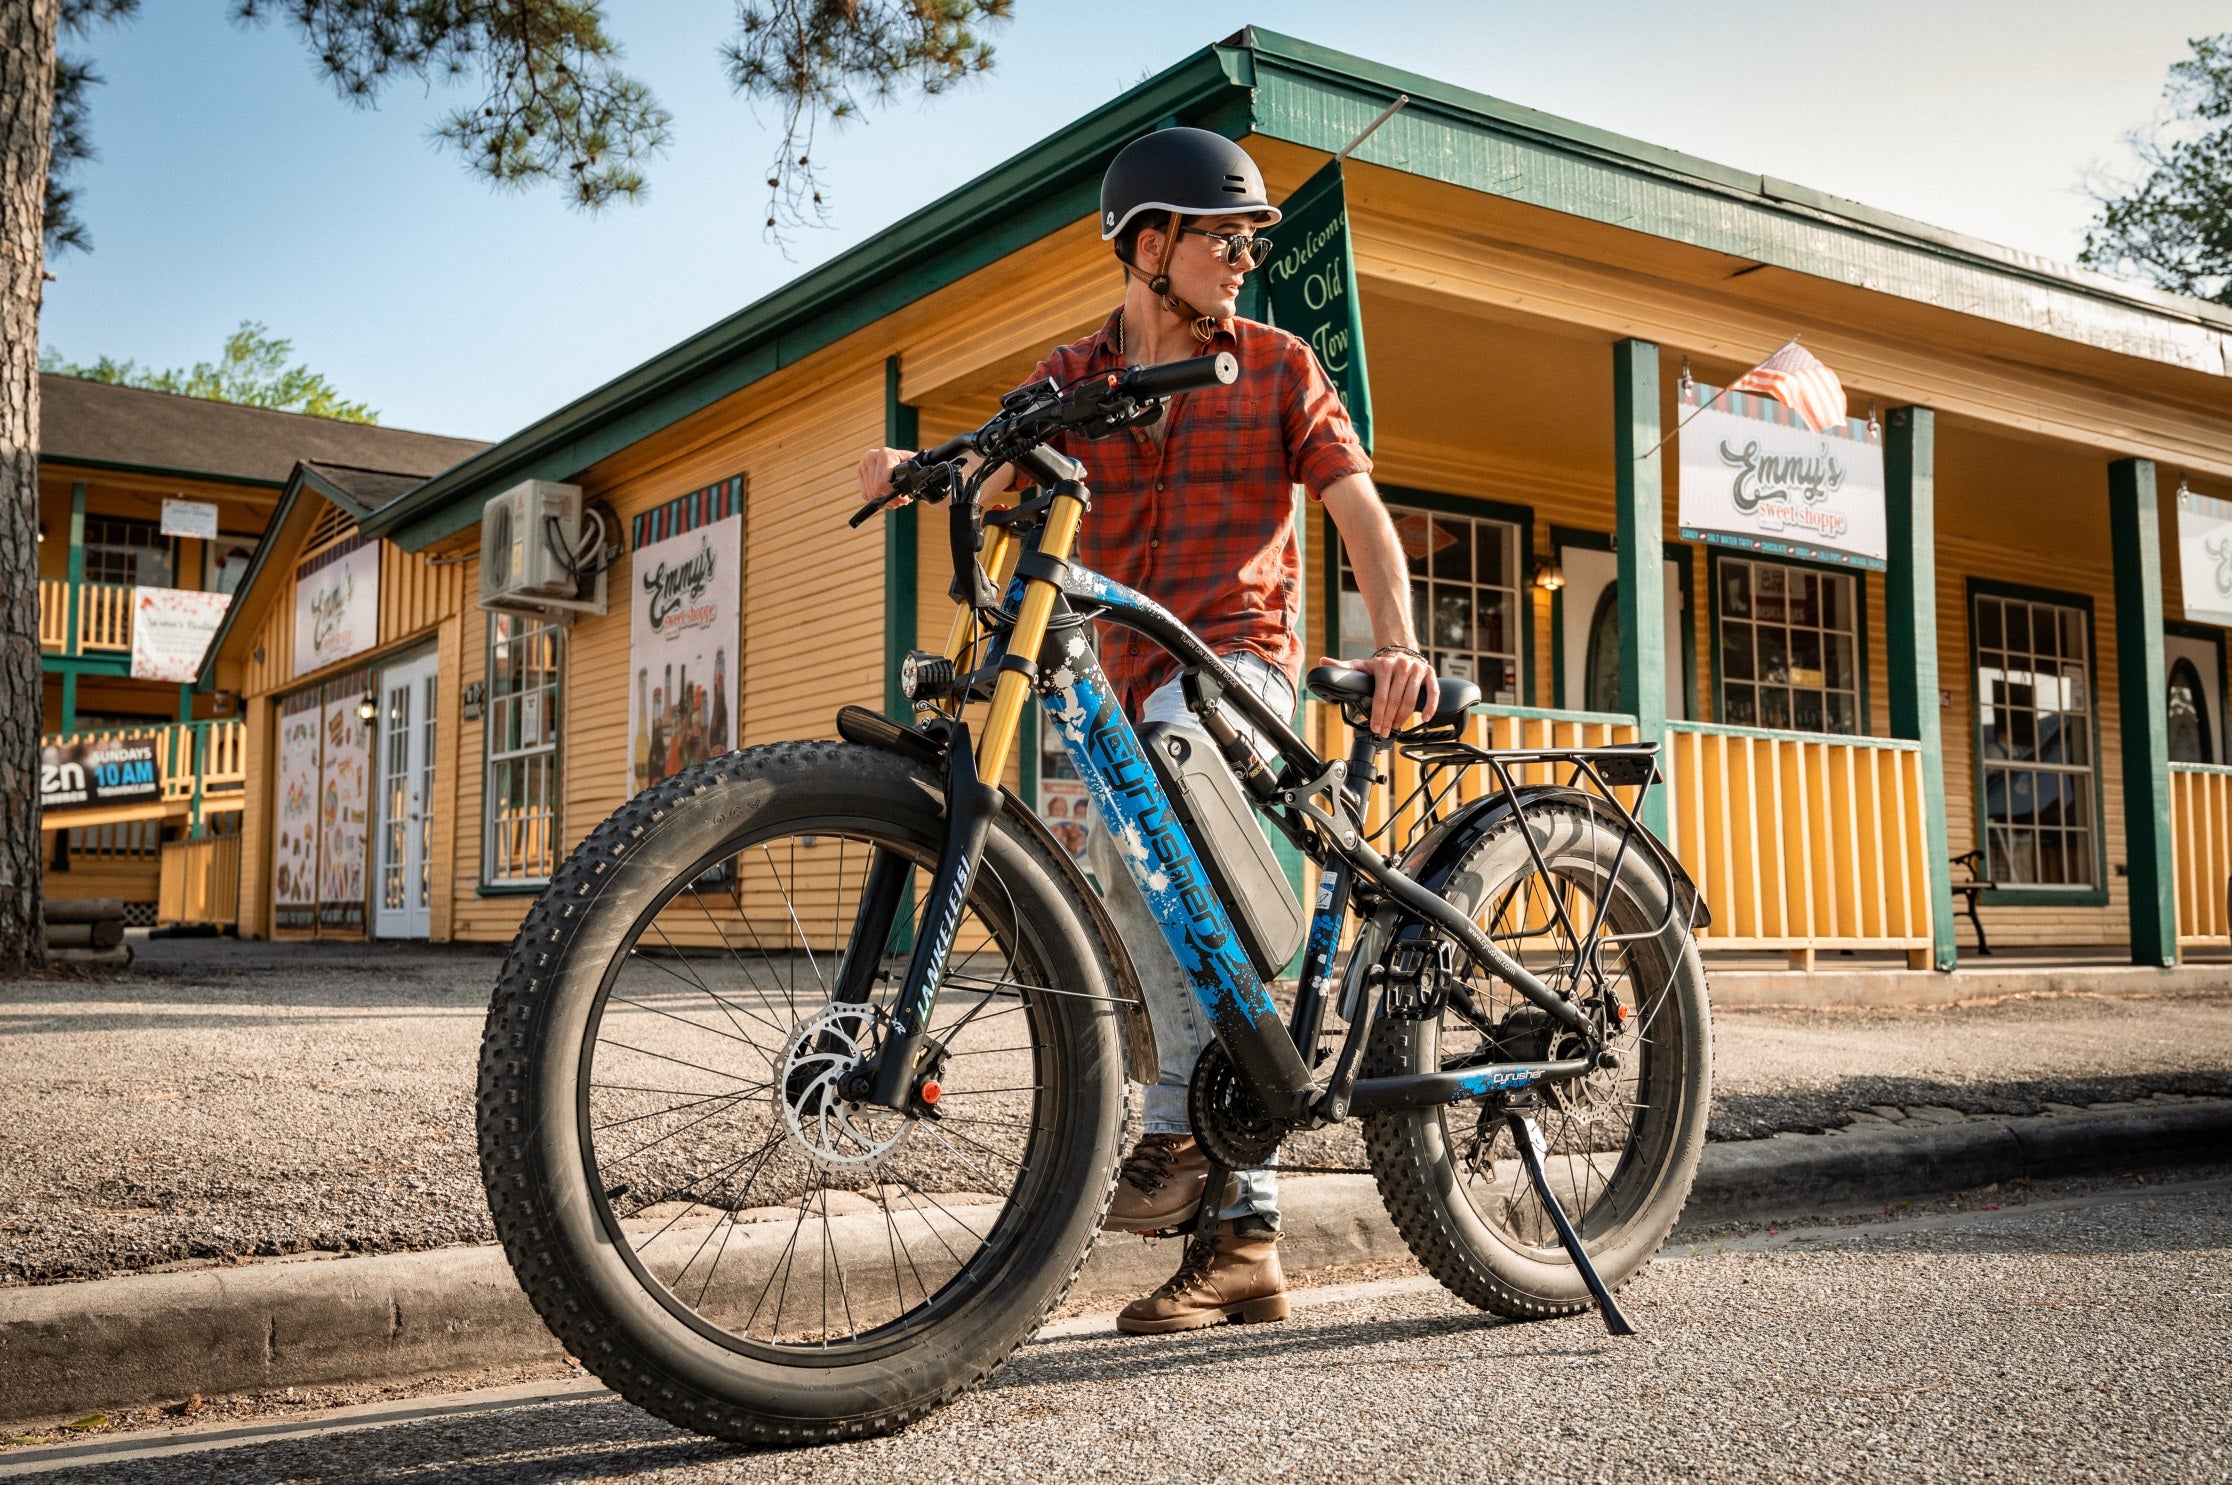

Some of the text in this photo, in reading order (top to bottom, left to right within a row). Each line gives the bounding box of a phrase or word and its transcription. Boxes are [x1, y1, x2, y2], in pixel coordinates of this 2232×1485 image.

[1269, 211, 1345, 284] Welcome
[1304, 257, 1343, 310] Old
[1719, 439, 1844, 510] Emmy's
[1760, 503, 1845, 533] sweet shoppe
[643, 535, 716, 628] Emmy's
[1180, 634, 1240, 689] TURN ON MOTION MODE
[93, 747, 152, 763] SUNDAYS
[94, 760, 154, 788] 10 AM
[917, 854, 971, 1024] LANKELEISI
[1467, 925, 1516, 976] www.cyrusher.com
[1493, 1069, 1545, 1085] Cyrusher
